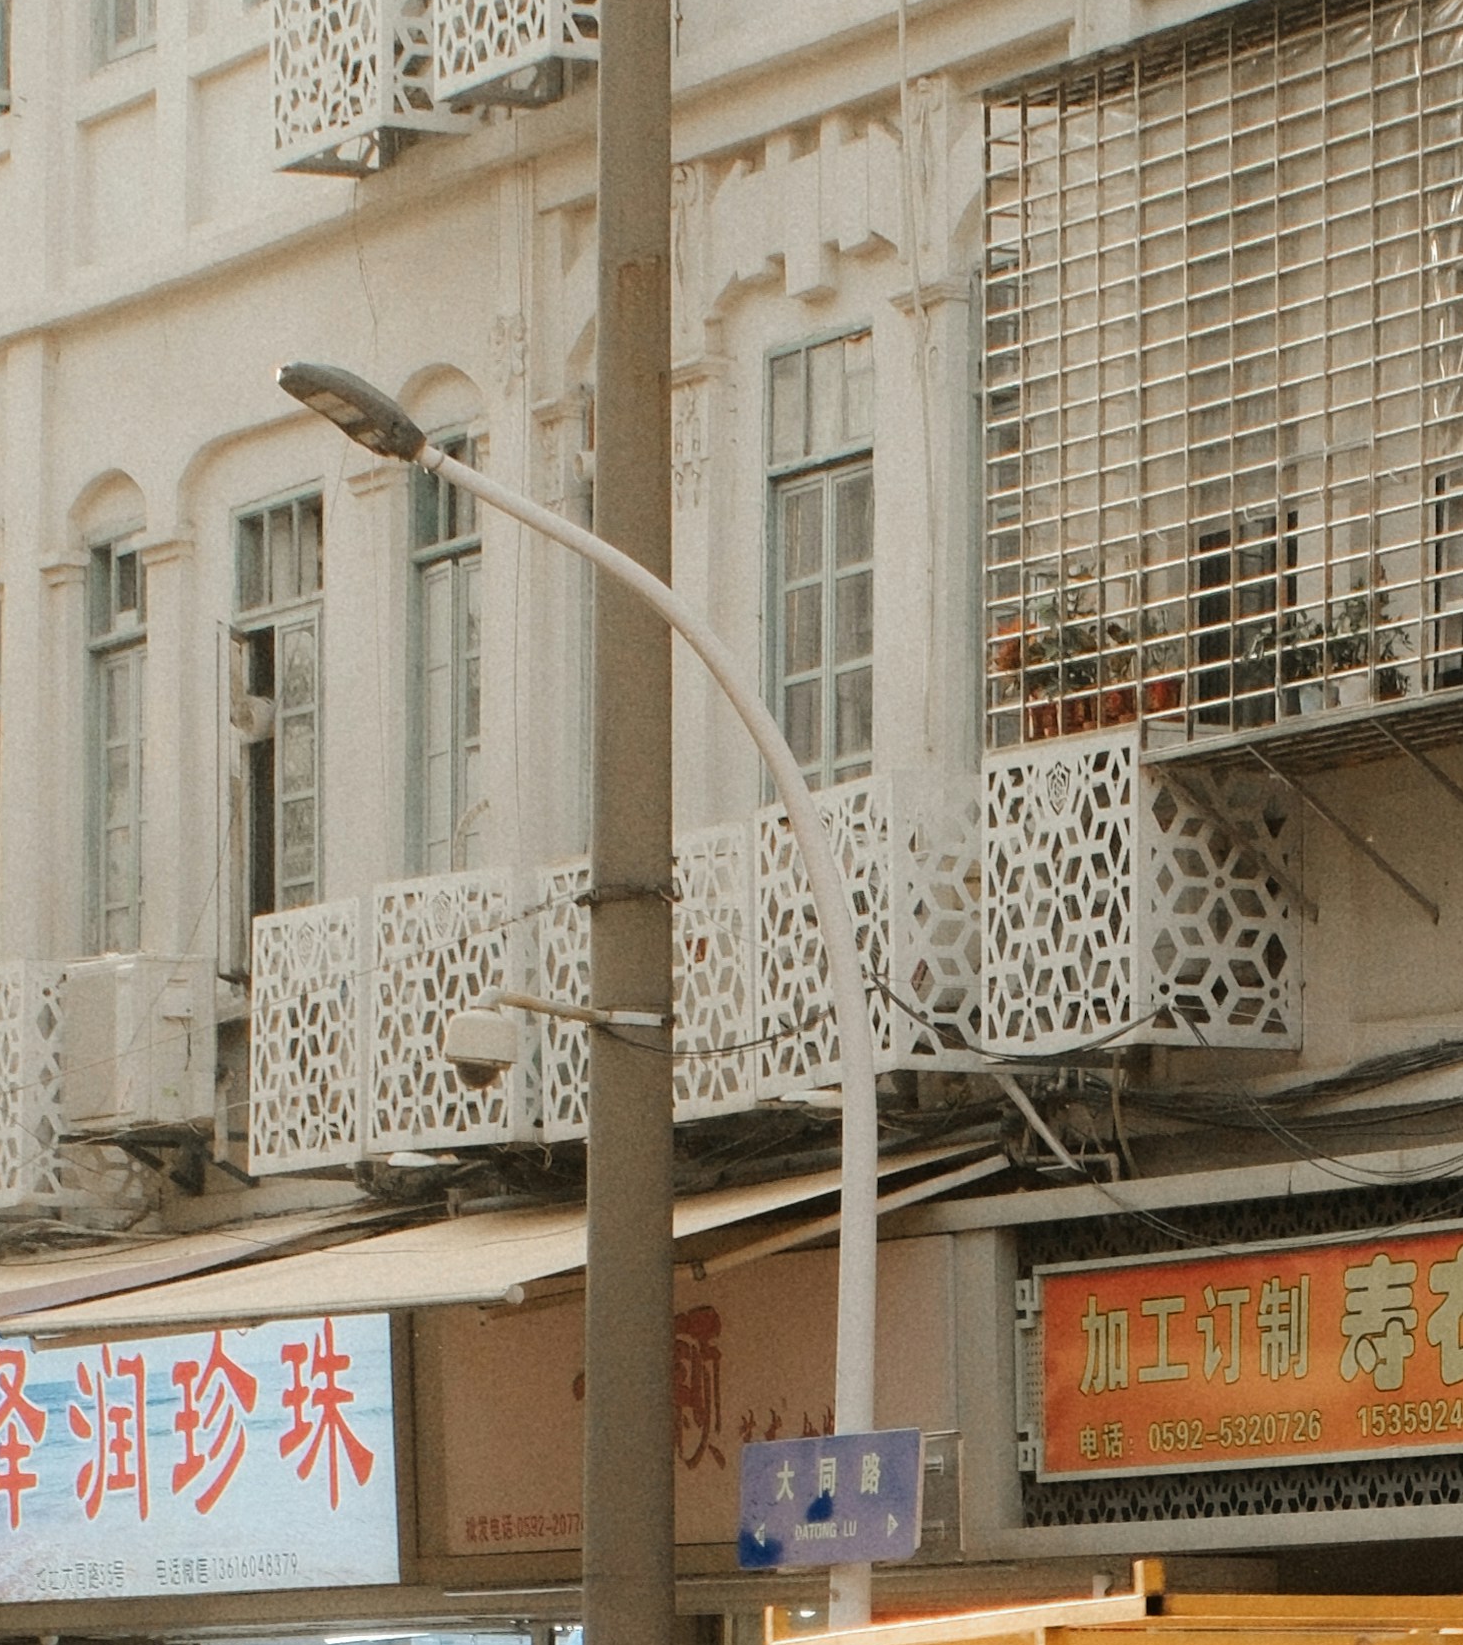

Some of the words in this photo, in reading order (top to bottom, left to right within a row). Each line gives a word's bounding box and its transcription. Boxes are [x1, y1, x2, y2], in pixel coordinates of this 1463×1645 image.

[1079, 1274, 1311, 1396] 加工订制
[776, 1453, 881, 1503] 大同路
[465, 1512, 584, 1543] 批发电话:0592-2077
[795, 1522, 838, 1541] DATONG
[843, 1520, 857, 1537] LU
